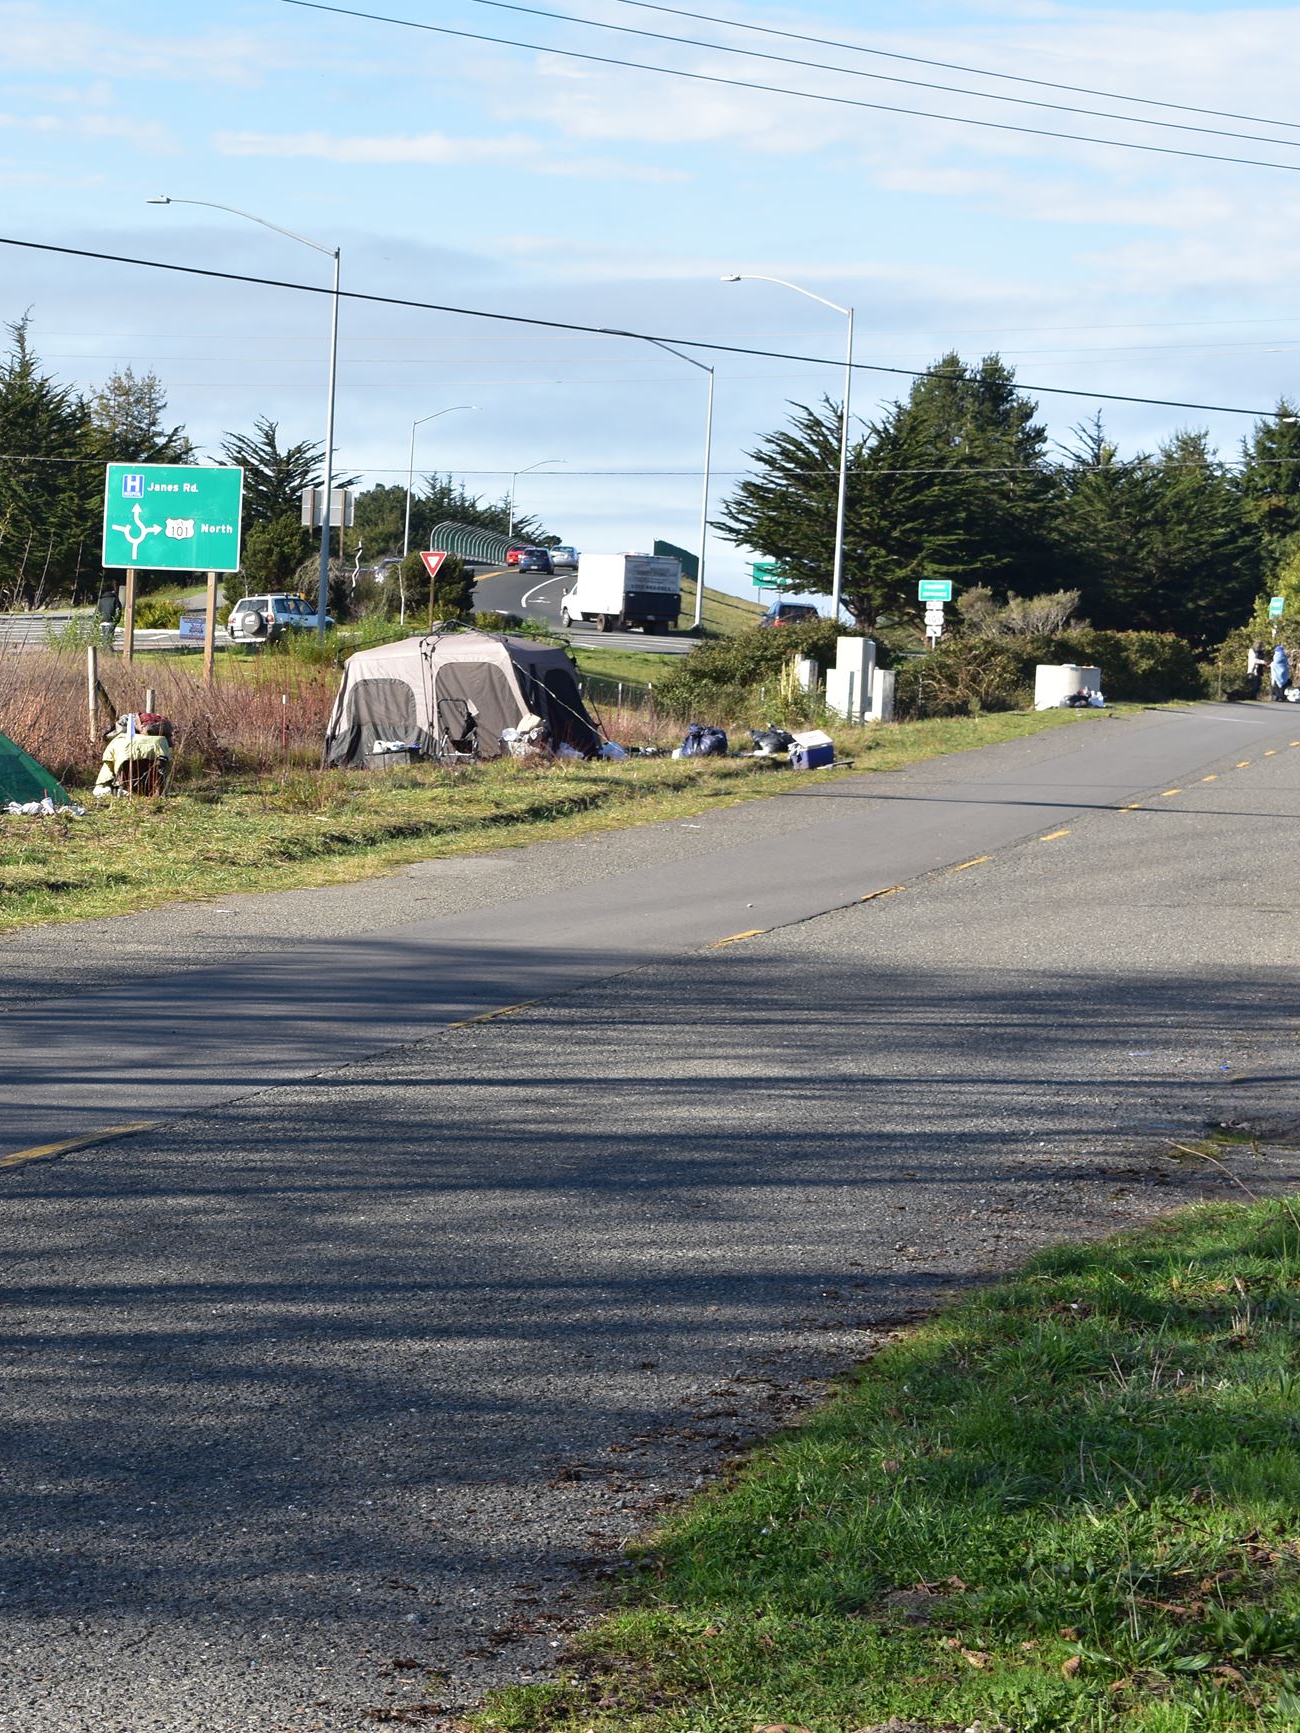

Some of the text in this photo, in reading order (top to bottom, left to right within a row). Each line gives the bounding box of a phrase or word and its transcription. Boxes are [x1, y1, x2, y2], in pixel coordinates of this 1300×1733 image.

[147, 482, 179, 492] Janes
[172, 523, 233, 537] 101 North
